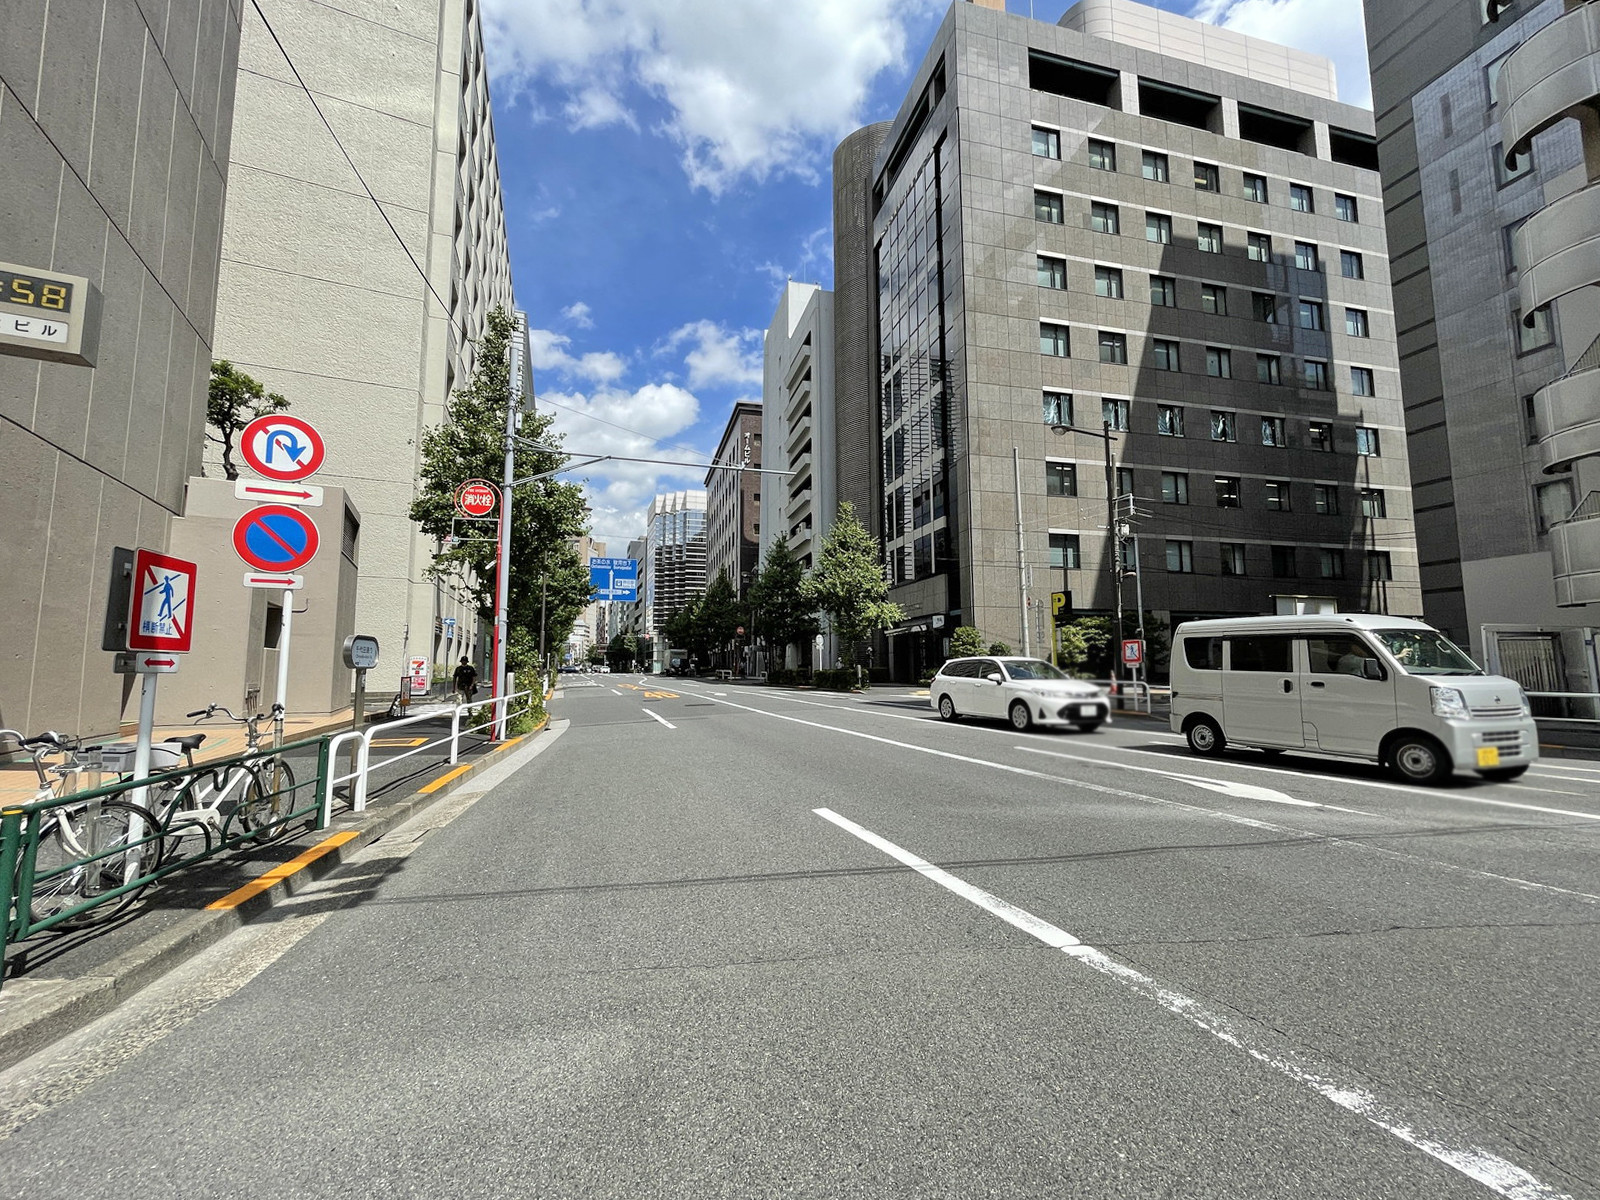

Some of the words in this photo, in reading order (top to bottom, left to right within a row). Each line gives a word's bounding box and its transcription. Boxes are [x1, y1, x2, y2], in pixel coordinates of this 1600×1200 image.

[464, 493, 492, 507] 消火栓
[1053, 593, 1066, 616] P
